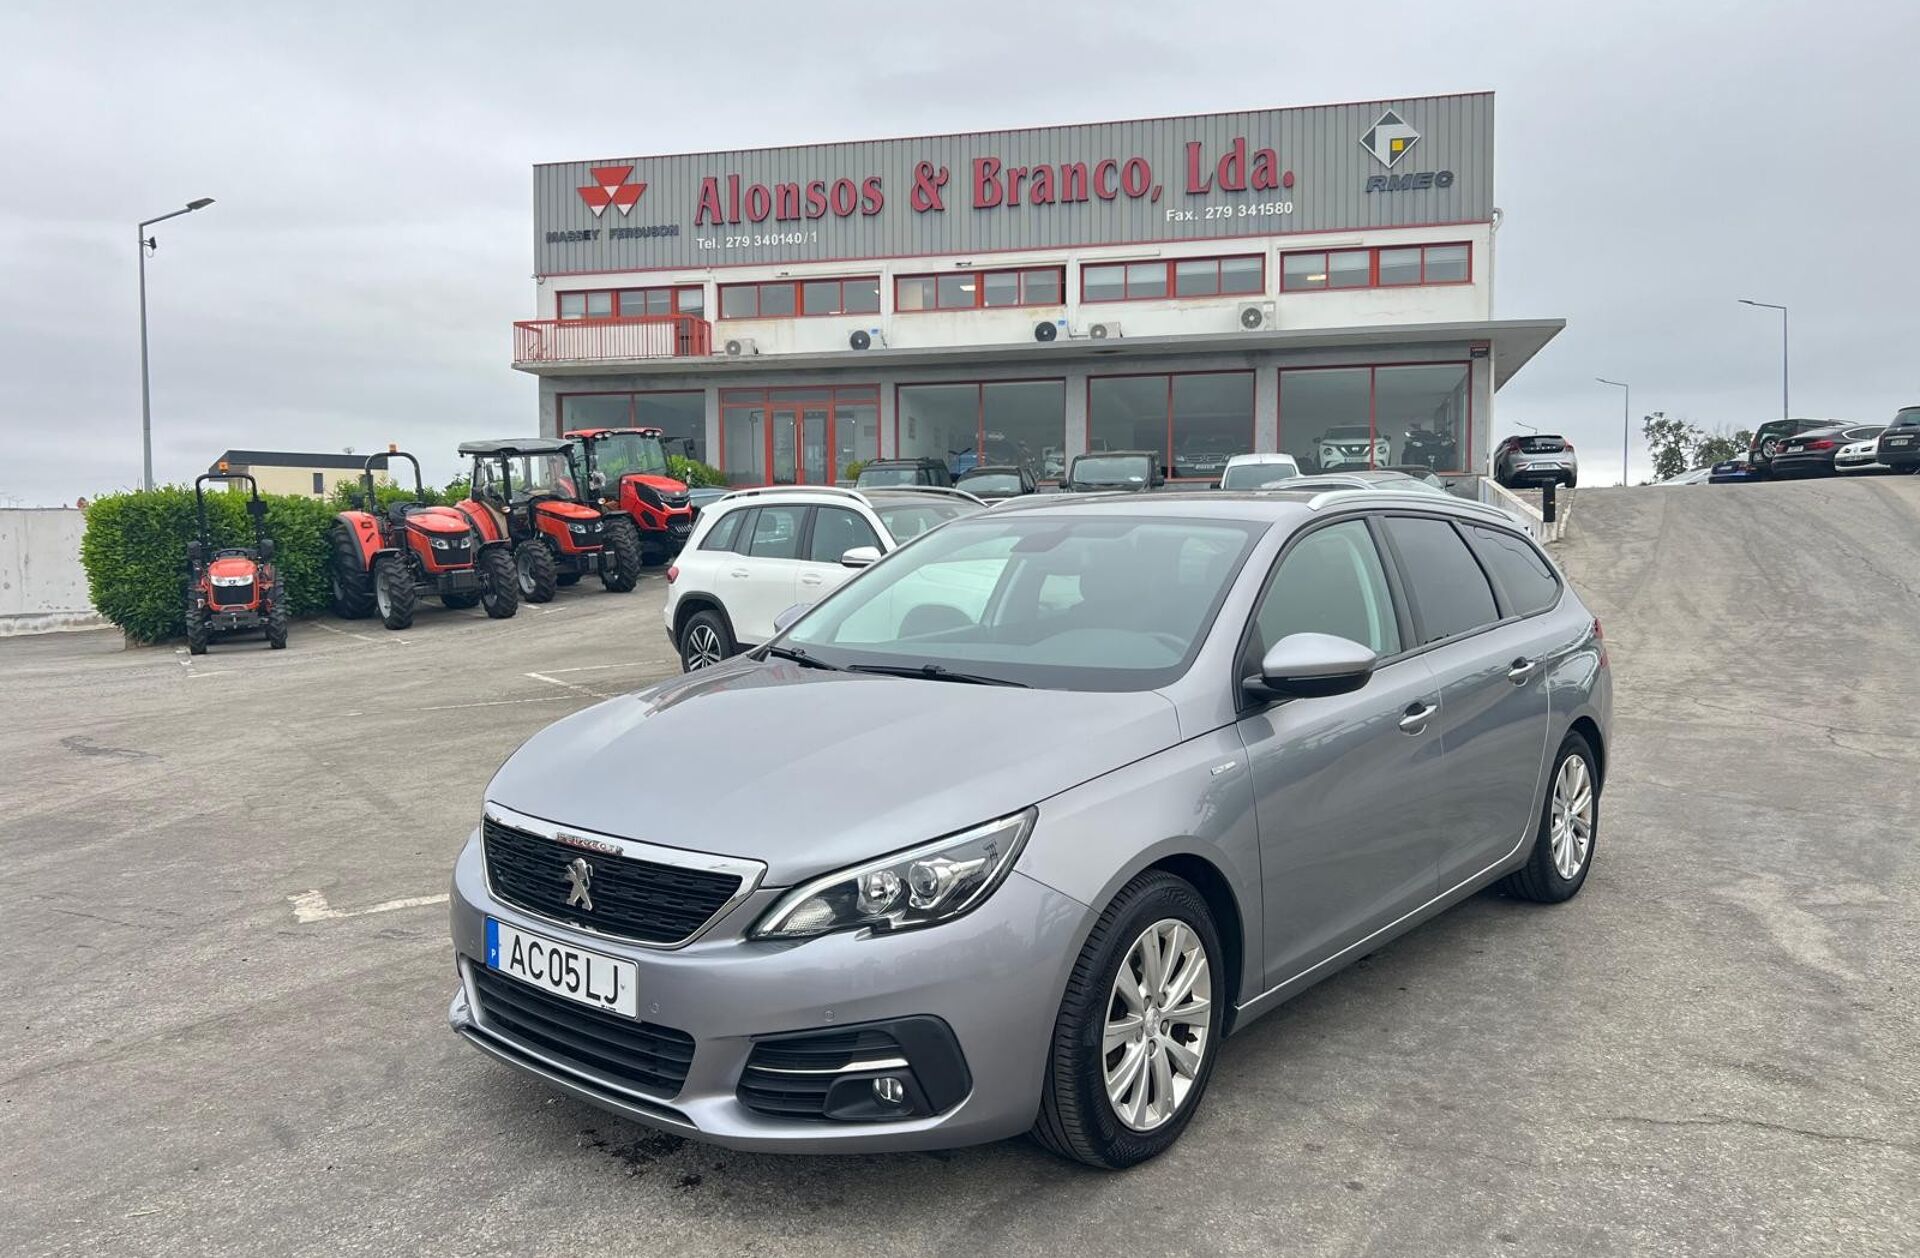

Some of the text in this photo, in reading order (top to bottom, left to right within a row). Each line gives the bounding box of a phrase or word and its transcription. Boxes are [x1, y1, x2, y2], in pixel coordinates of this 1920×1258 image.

[695, 137, 1295, 226] Alonsos & Branco, Lda.
[1166, 202, 1293, 221] Fax. 279 341580
[546, 224, 679, 243] MASSEY FERGUSON
[696, 231, 817, 250] Tel. 279 340140/1
[491, 948, 496, 958] P
